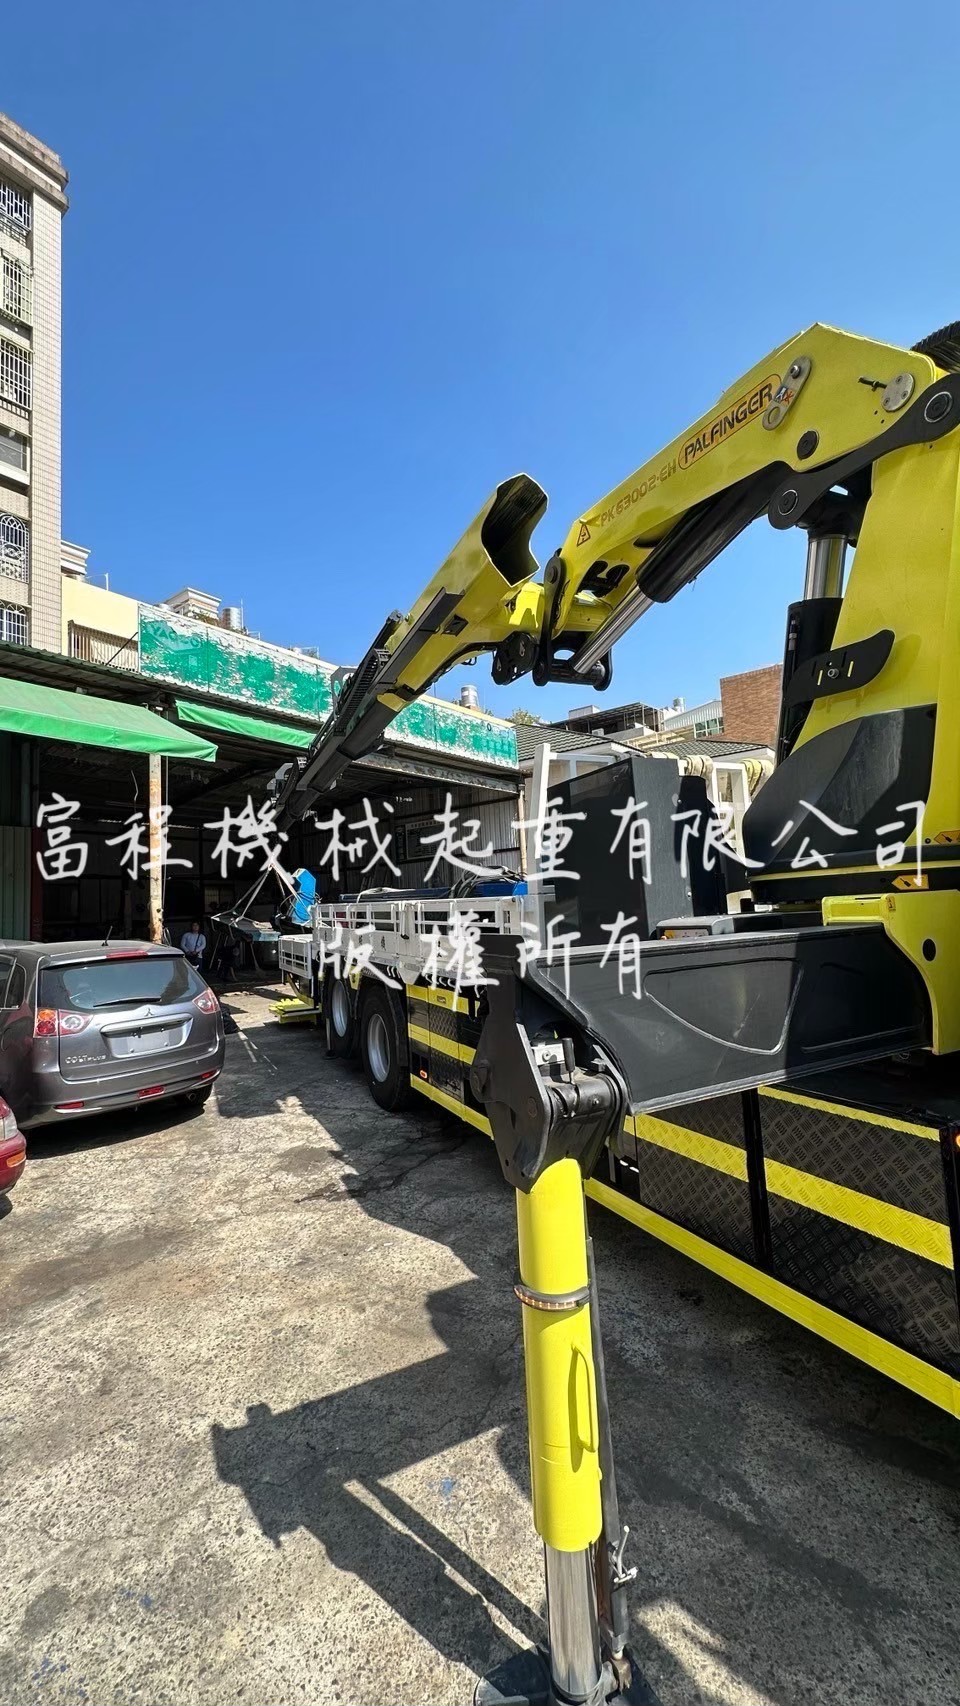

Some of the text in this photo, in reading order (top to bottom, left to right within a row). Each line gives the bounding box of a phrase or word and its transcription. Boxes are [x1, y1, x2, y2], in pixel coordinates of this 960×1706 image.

[684, 383, 774, 464] PALFINGER
[600, 505, 615, 526] PK
[65, 1055, 88, 1064] COLT
